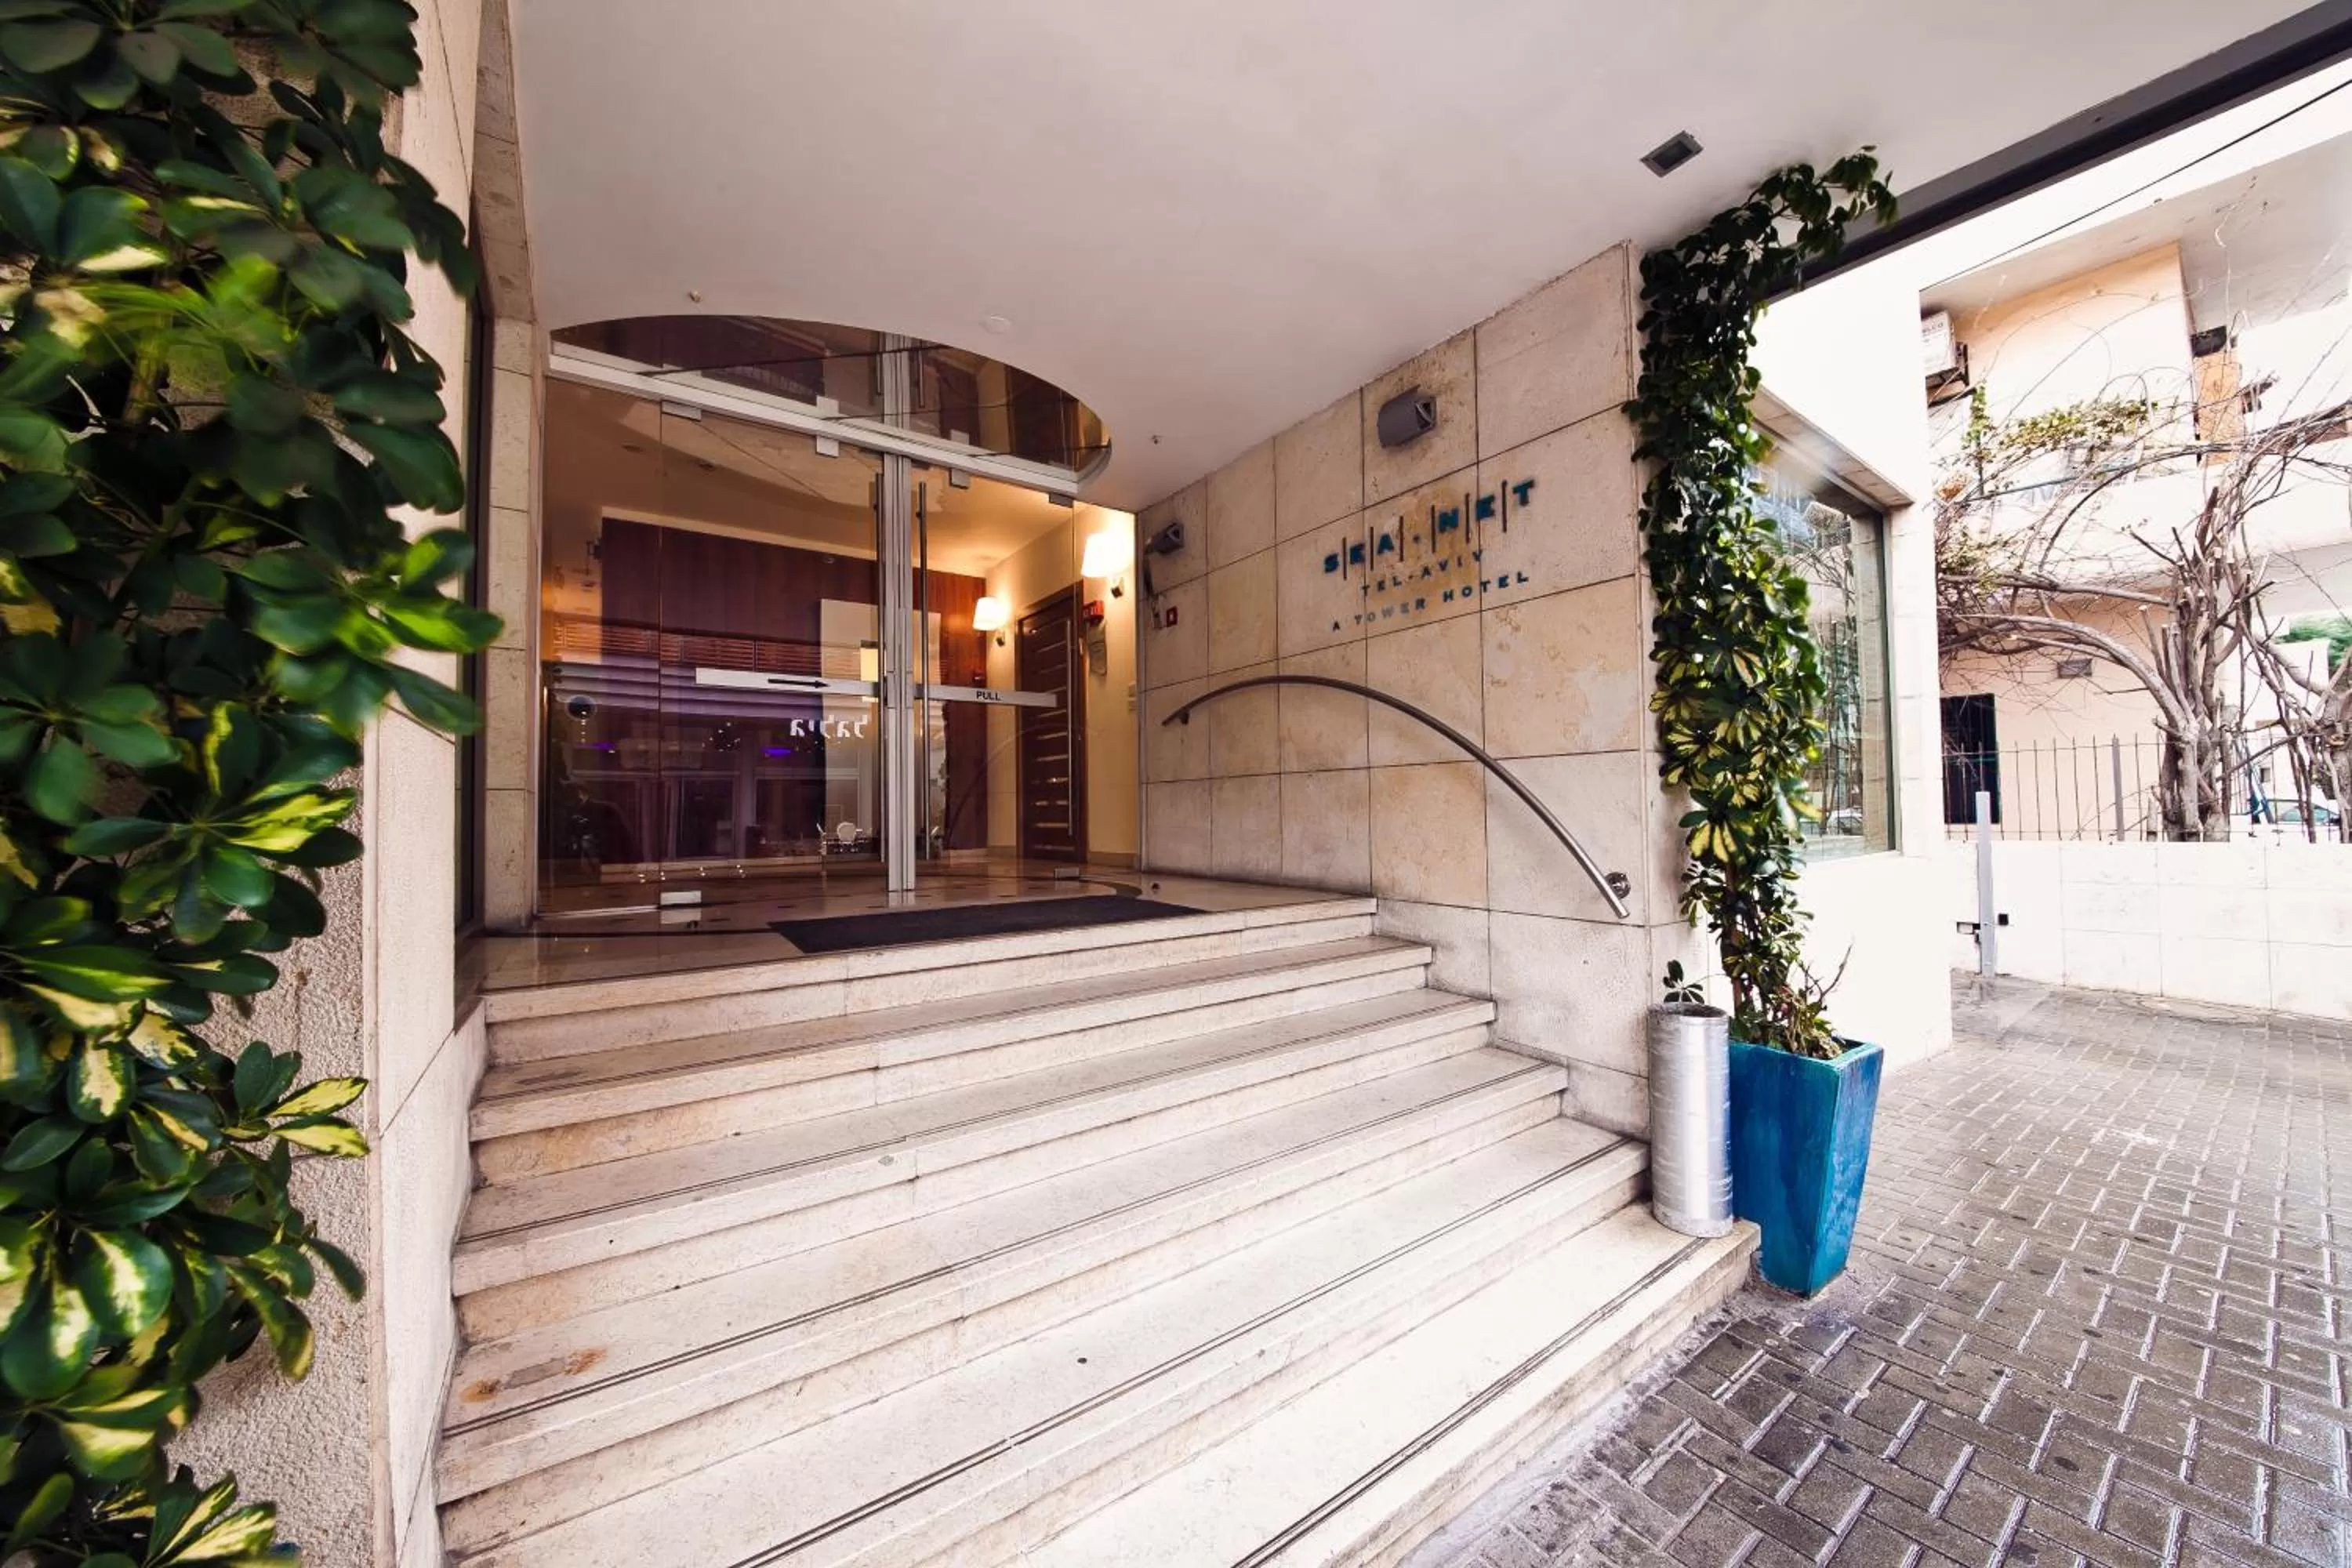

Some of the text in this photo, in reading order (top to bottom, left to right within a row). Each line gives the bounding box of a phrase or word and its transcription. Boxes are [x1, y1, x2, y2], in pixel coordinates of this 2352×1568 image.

[1332, 571, 1529, 632] A TOWER HOTEL
[976, 691, 1002, 701] PULL
